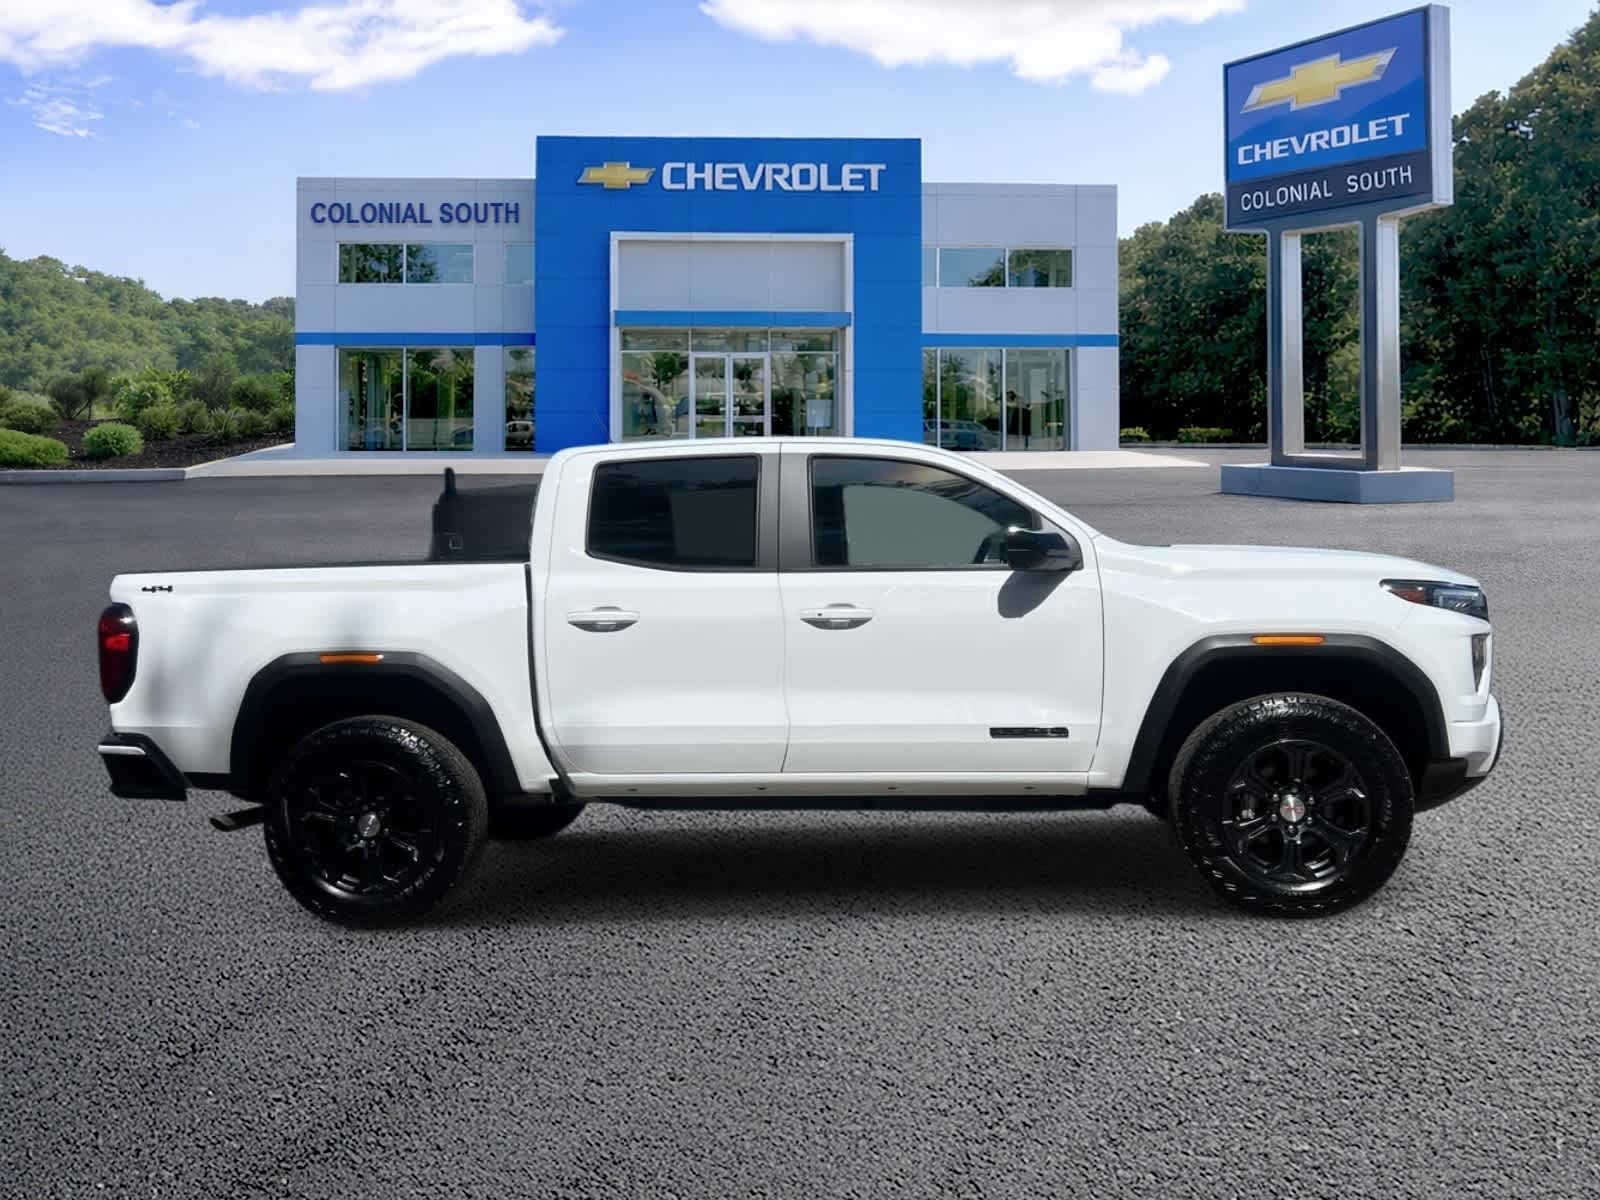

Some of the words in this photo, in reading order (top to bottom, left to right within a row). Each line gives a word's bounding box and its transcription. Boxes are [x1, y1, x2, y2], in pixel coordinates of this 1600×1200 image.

[1238, 113, 1410, 165] CHEVROLET
[662, 162, 886, 192] CHEVROLET
[1241, 179, 1333, 211] COLONIAL
[1346, 165, 1413, 193] SOUTH
[311, 203, 431, 224] COLONIAL
[439, 203, 520, 224] SOUTH
